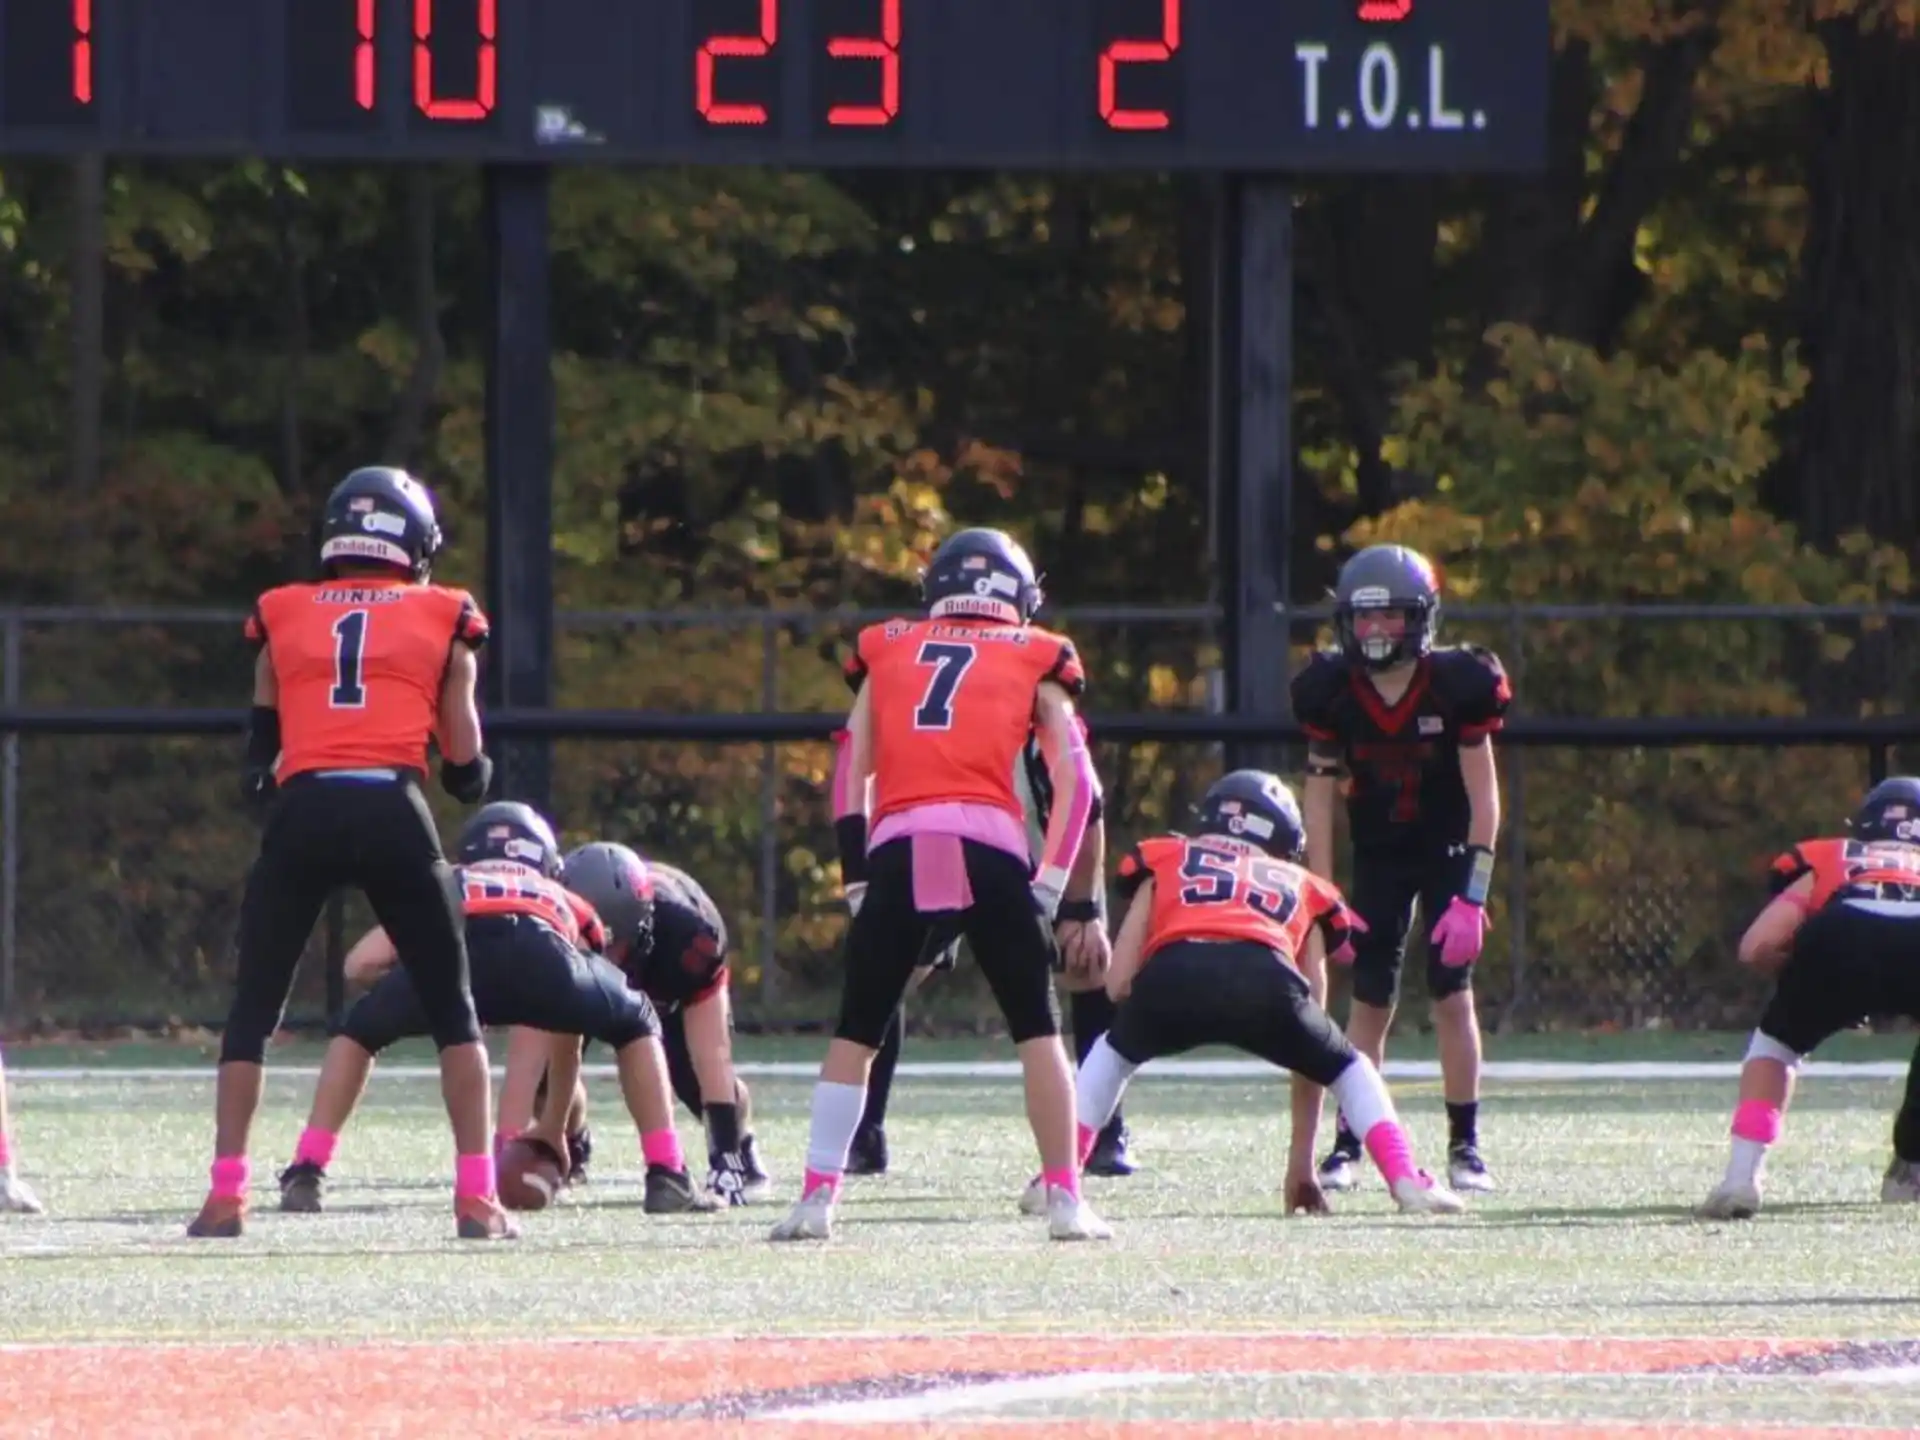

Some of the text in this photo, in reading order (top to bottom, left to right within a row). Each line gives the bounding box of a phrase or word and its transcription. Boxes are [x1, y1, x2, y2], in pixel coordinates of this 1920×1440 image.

[1295, 42, 1486, 128] T.O.L.
[944, 599, 1002, 615] Riddell
[328, 608, 369, 708] 1
[913, 640, 977, 730] 7
[1177, 844, 1300, 925] 55
